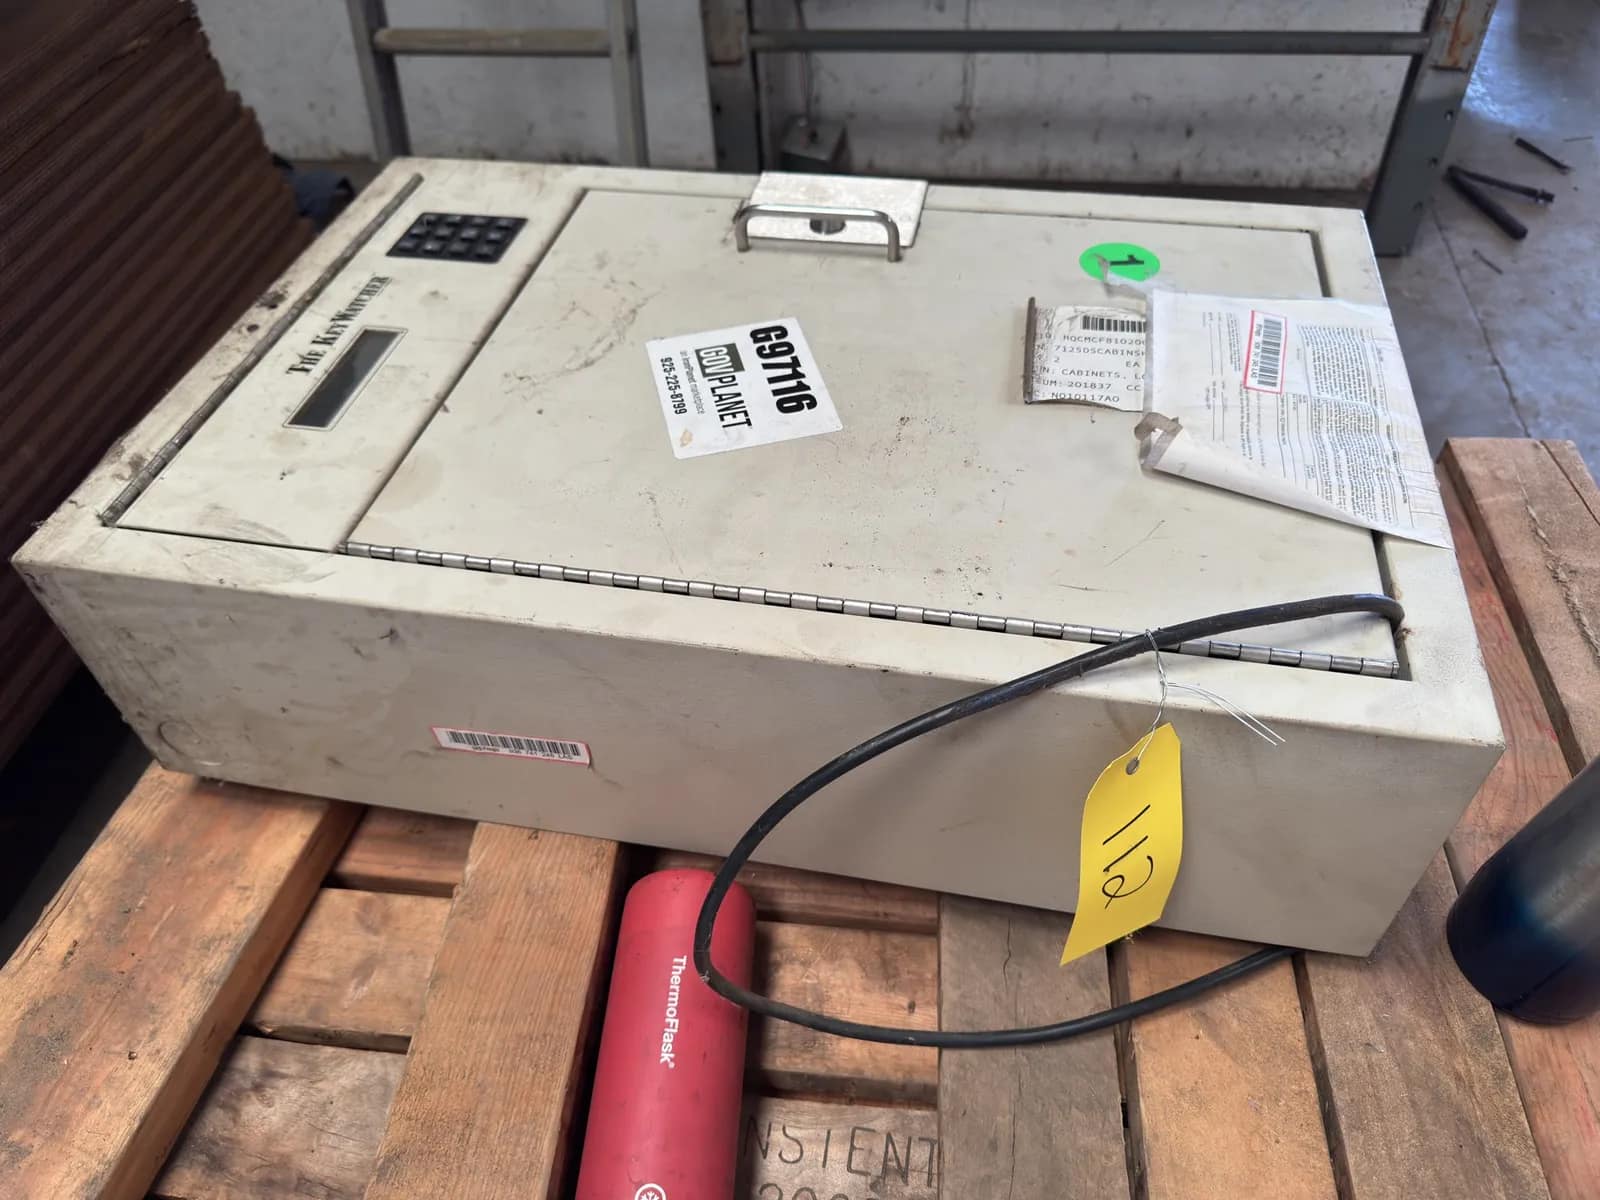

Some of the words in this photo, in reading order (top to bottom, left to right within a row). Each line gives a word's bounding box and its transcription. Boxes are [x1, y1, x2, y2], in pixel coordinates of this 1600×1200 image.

[660, 357, 688, 415] 925-225-8799
[750, 325, 818, 414] G97116
[1067, 381, 1112, 390] 201837
